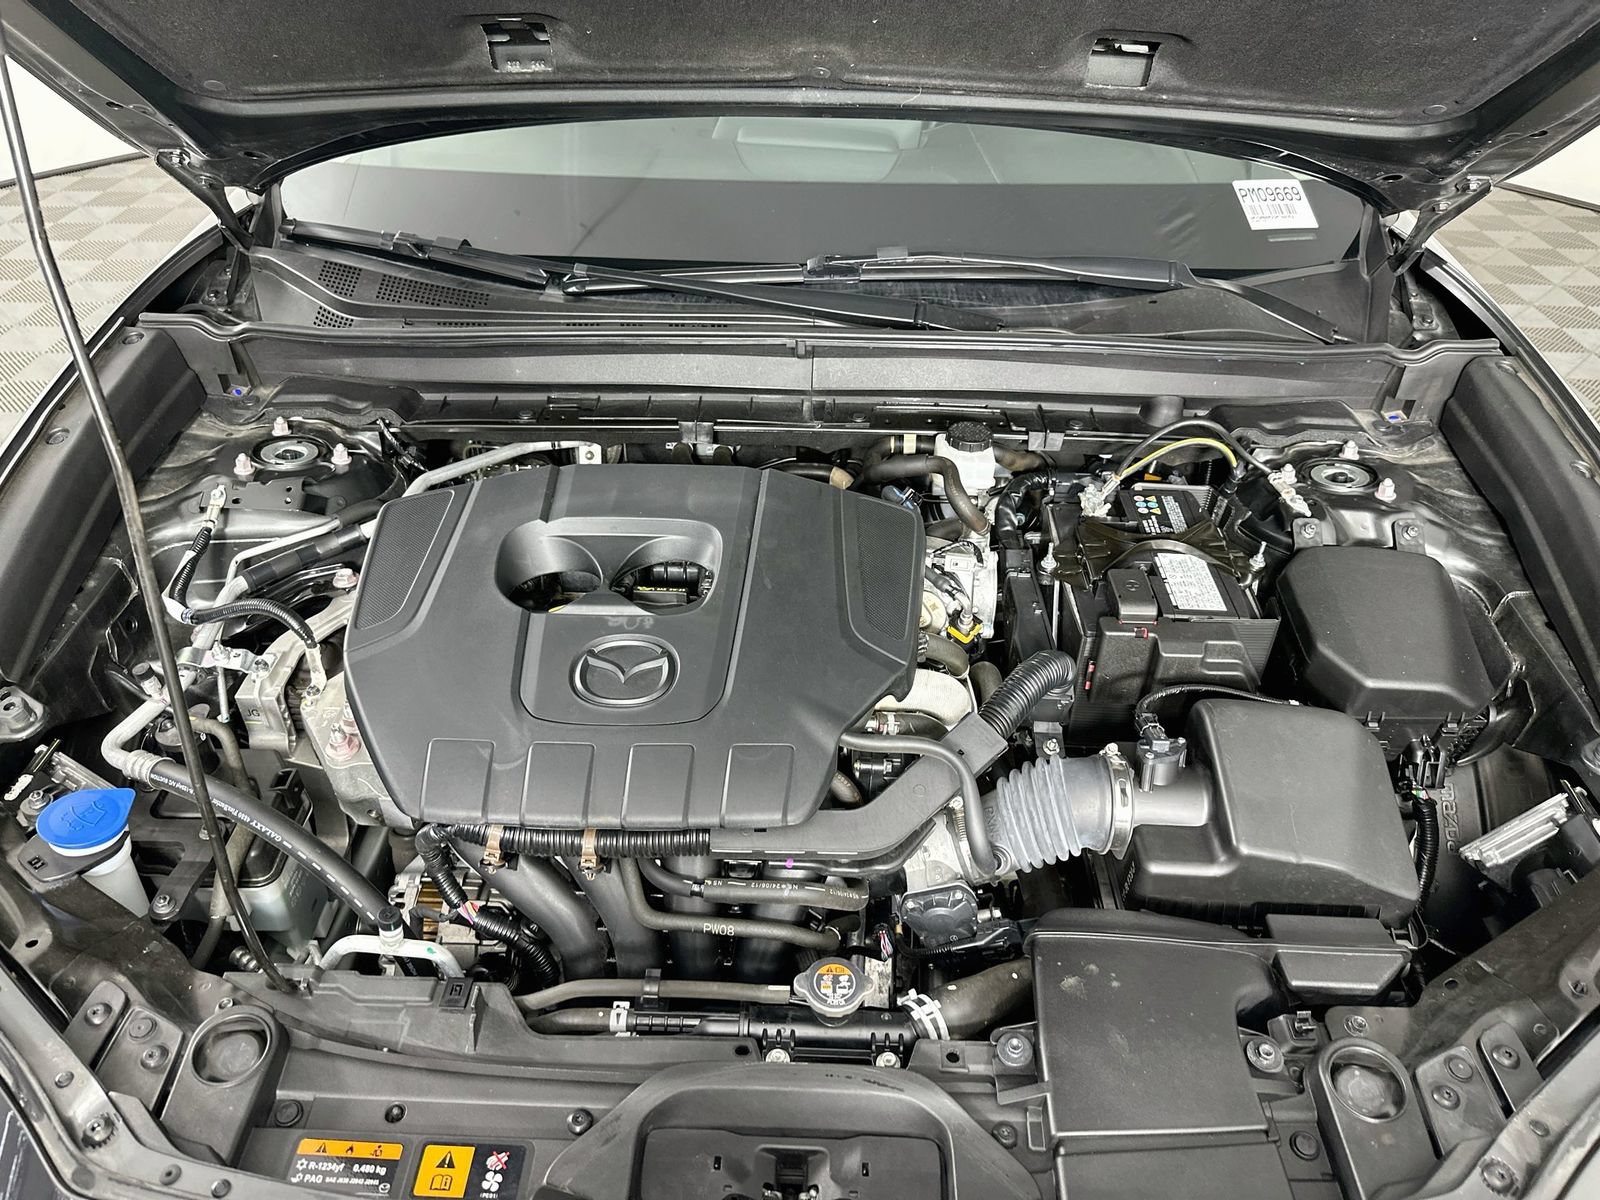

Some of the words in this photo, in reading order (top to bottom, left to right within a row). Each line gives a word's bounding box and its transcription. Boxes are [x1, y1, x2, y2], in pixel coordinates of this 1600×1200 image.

[1238, 186, 1302, 203] PM09669
[250, 820, 282, 842] GALAXY
[703, 922, 735, 936] PW08
[308, 1161, 345, 1173] R-1234yf
[375, 1164, 387, 1176] kg
